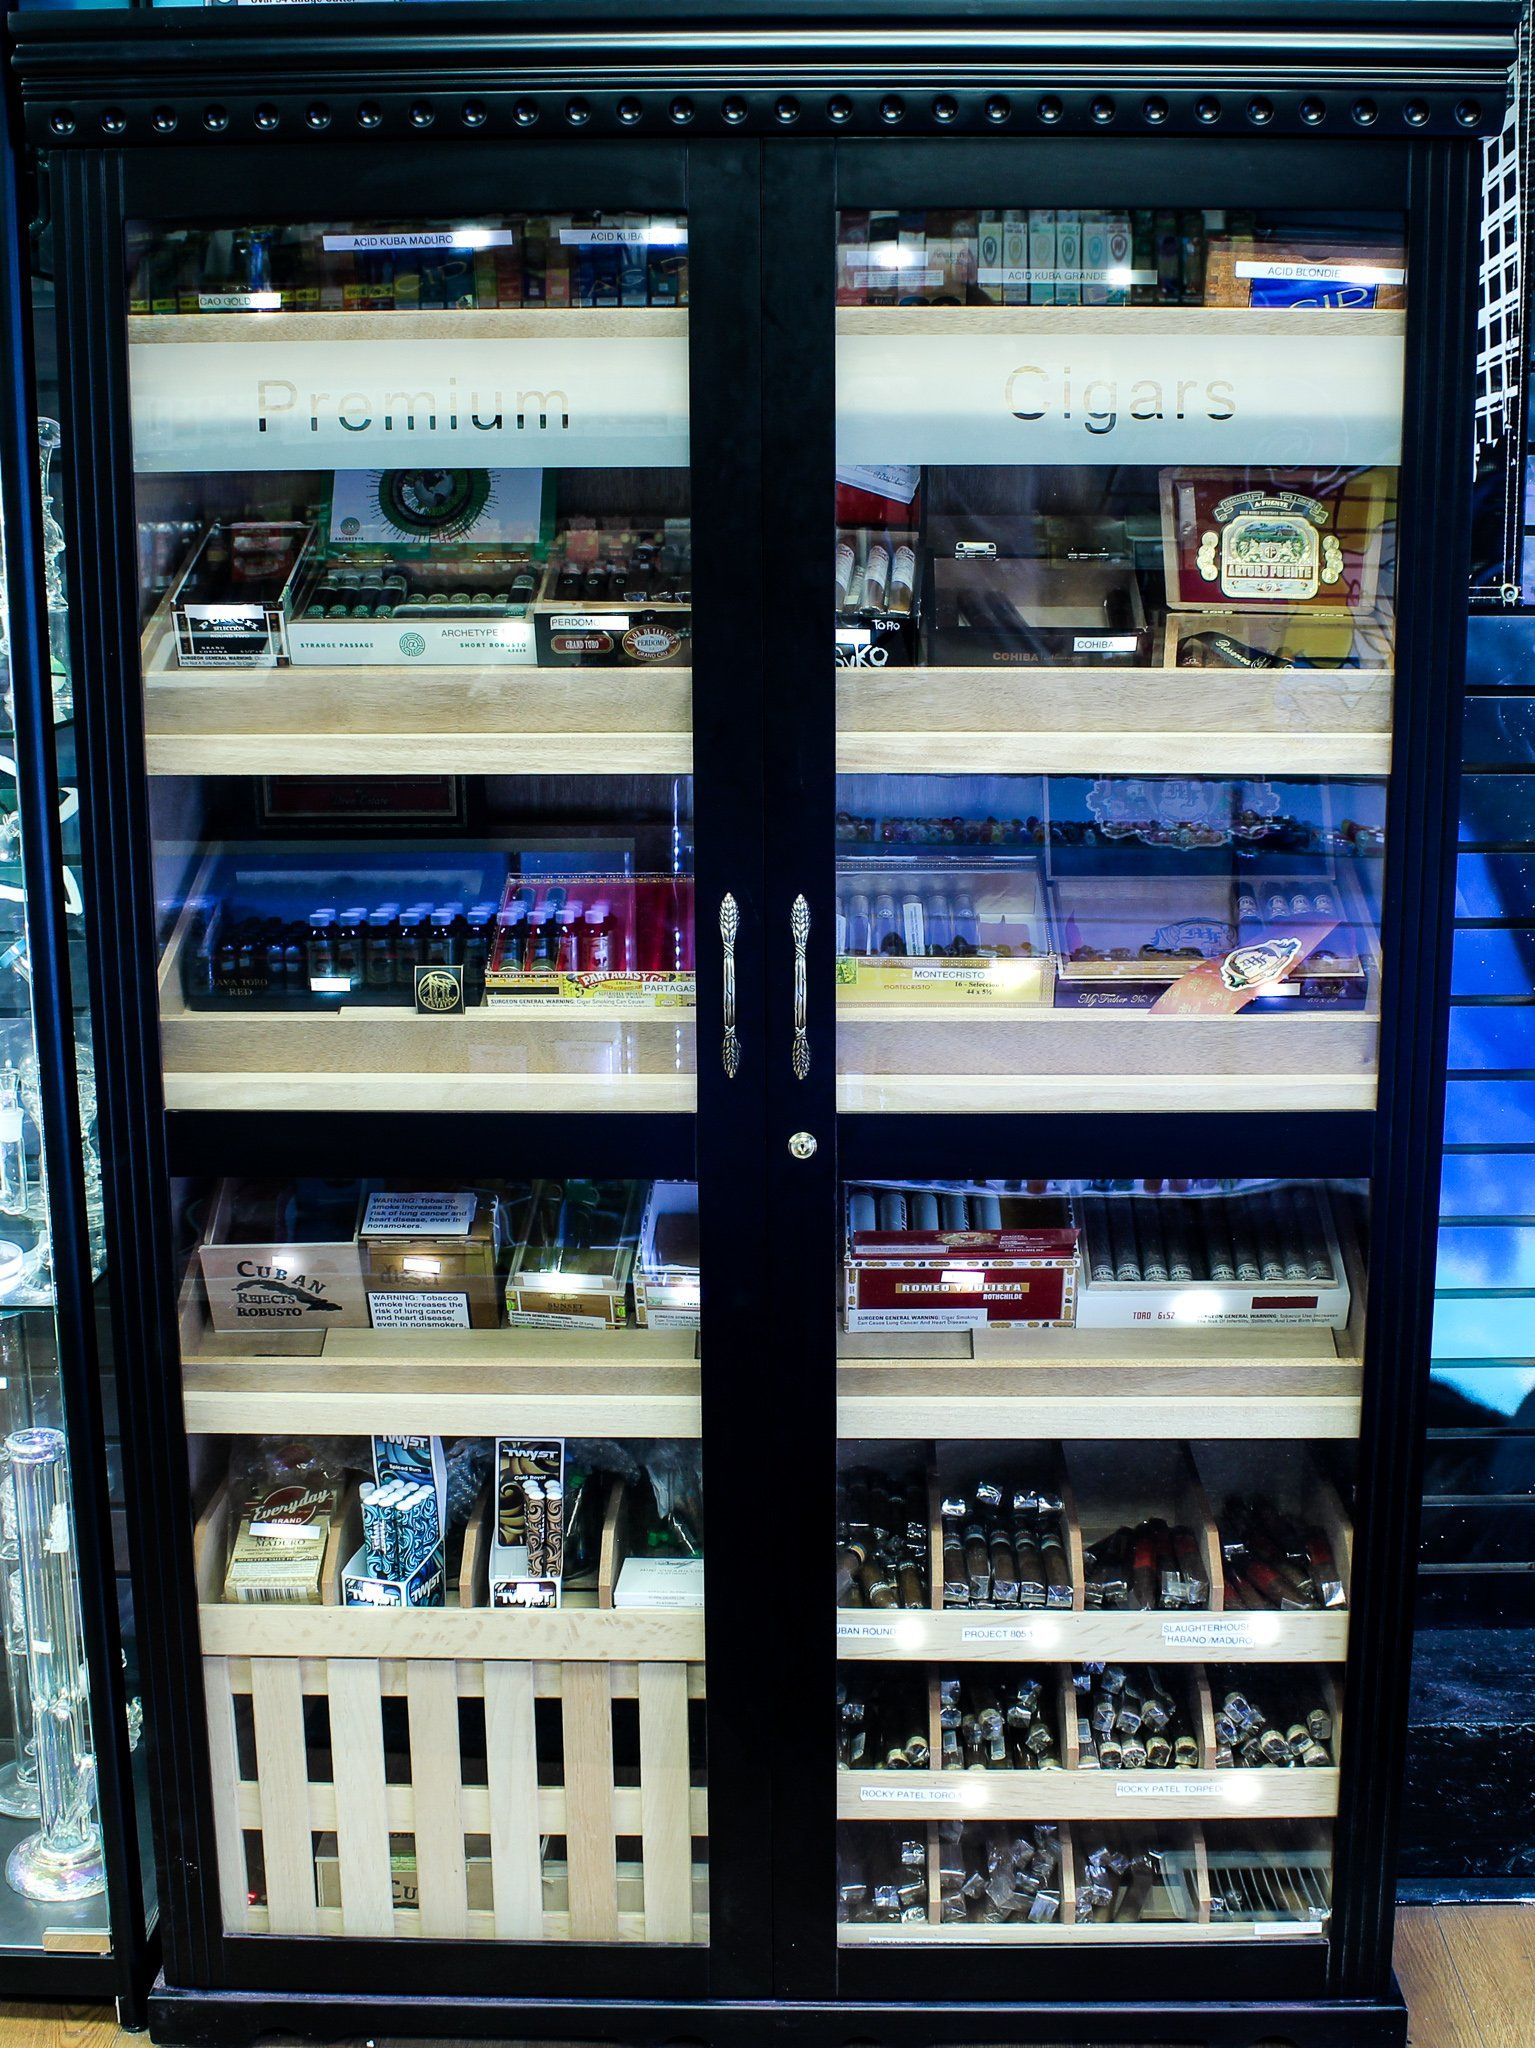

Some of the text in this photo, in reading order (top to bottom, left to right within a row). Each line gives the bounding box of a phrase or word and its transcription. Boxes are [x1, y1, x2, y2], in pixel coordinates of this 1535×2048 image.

[354, 235, 453, 246] ACID KUBA MADURO
[590, 232, 644, 241] ACID KUBA
[1008, 271, 1106, 280] ACID KUBA GRANDE
[1268, 266, 1340, 278] ACID BLONDIE
[200, 296, 251, 306] CAO GOLD
[1004, 365, 1235, 434] Cigars
[257, 377, 570, 432] Premium
[1228, 565, 1312, 578] ARTURO FUENTE
[551, 618, 600, 627] PERDOMO
[872, 619, 900, 631] TORO
[442, 628, 498, 638] ARCHETYPE
[565, 640, 584, 650] GRAND
[1076, 640, 1114, 649] COHIBA
[992, 652, 1038, 662] COHIBA
[914, 970, 984, 980] MONTECRISTO
[229, 988, 253, 996] RED
[644, 984, 696, 993] PARTAGAS
[399, 1210, 418, 1218] lung
[237, 1260, 327, 1294] CUBAN
[902, 1284, 950, 1292] ROMEO
[238, 1293, 296, 1304] REJECTS
[547, 1302, 584, 1310] SUNSET
[236, 1307, 302, 1317] ROBUSTO
[404, 1308, 424, 1316] lung
[1132, 1312, 1152, 1320] TORO
[251, 1488, 330, 1522] Everyday
[964, 1630, 1026, 1638] PROJECT 805
[1167, 1636, 1207, 1644] HABANO
[1117, 1785, 1149, 1793] ROCKY
[1152, 1785, 1180, 1793] PATEL
[862, 1790, 894, 1798] ROCKY
[897, 1790, 926, 1798] PATEL
